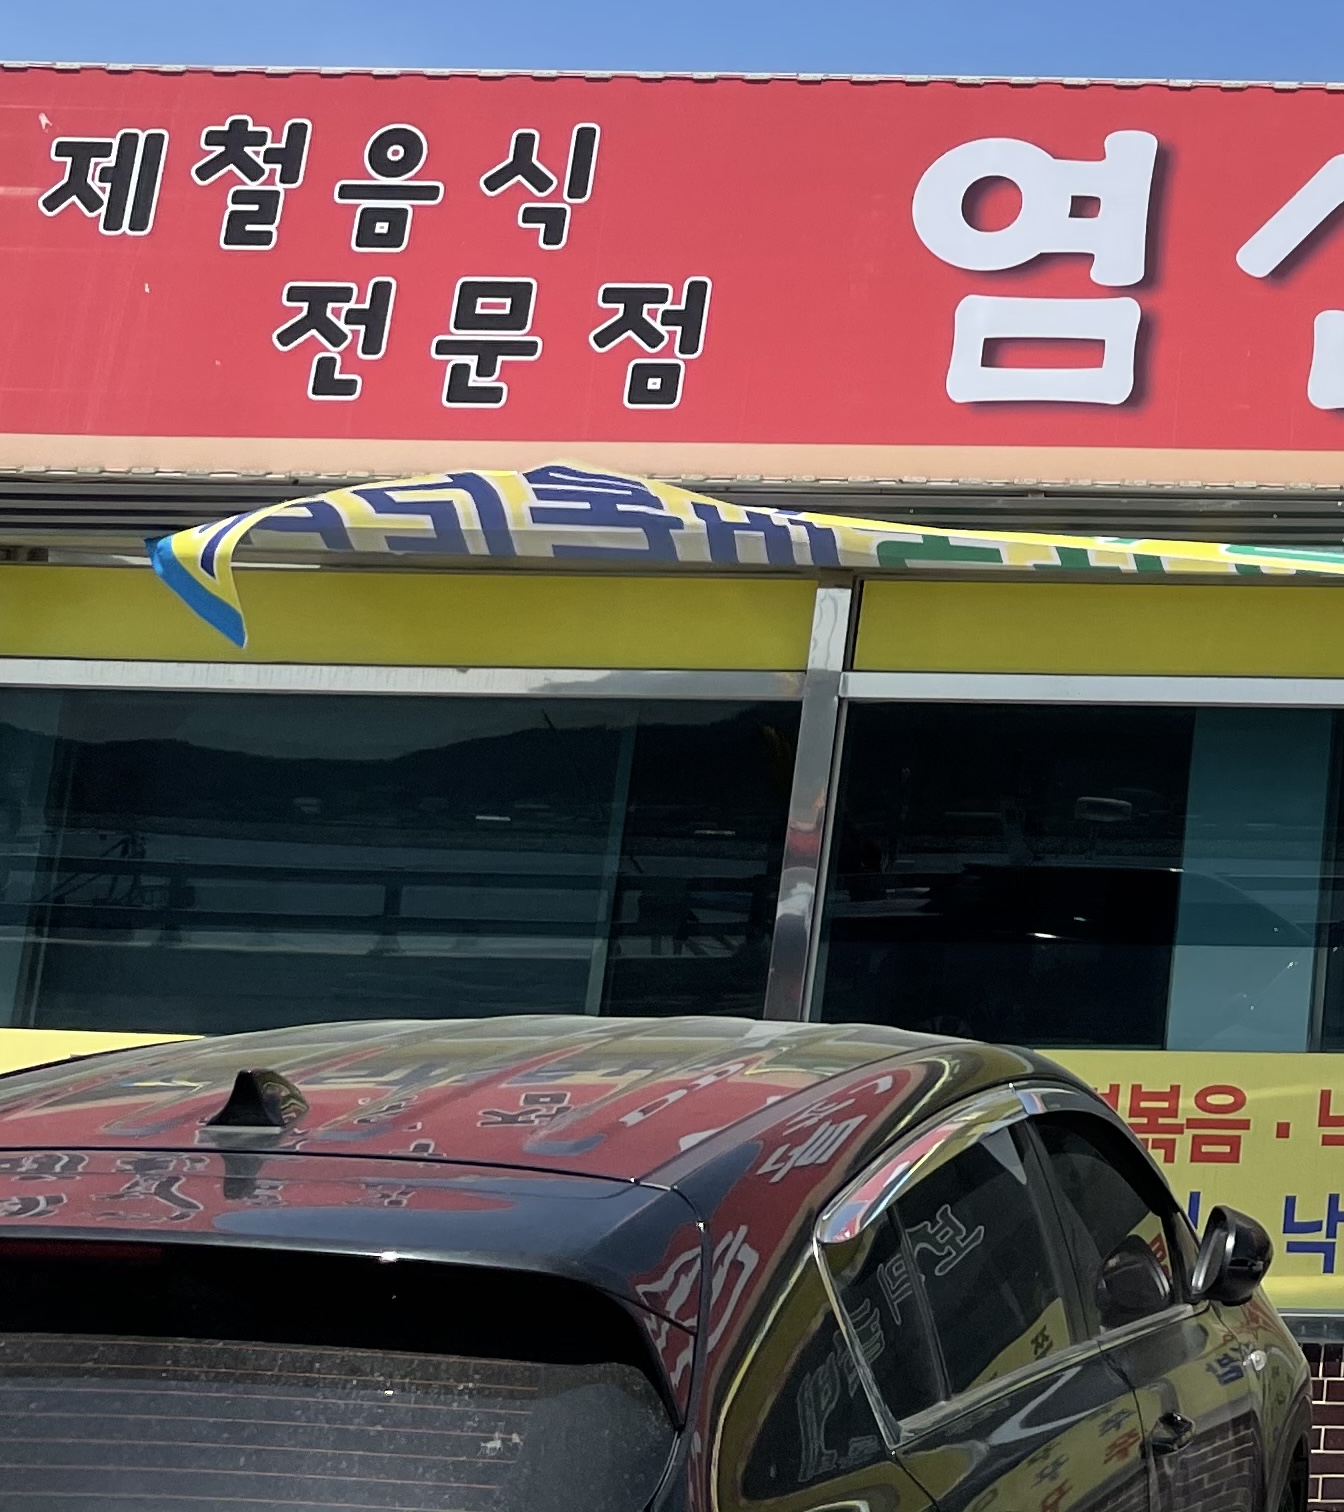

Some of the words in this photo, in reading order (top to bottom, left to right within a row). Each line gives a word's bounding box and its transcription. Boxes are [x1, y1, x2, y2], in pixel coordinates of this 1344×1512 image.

[38, 114, 601, 252] 제철음식
[273, 276, 712, 409] 전문점
[1094, 1083, 1252, 1164] 볶음
